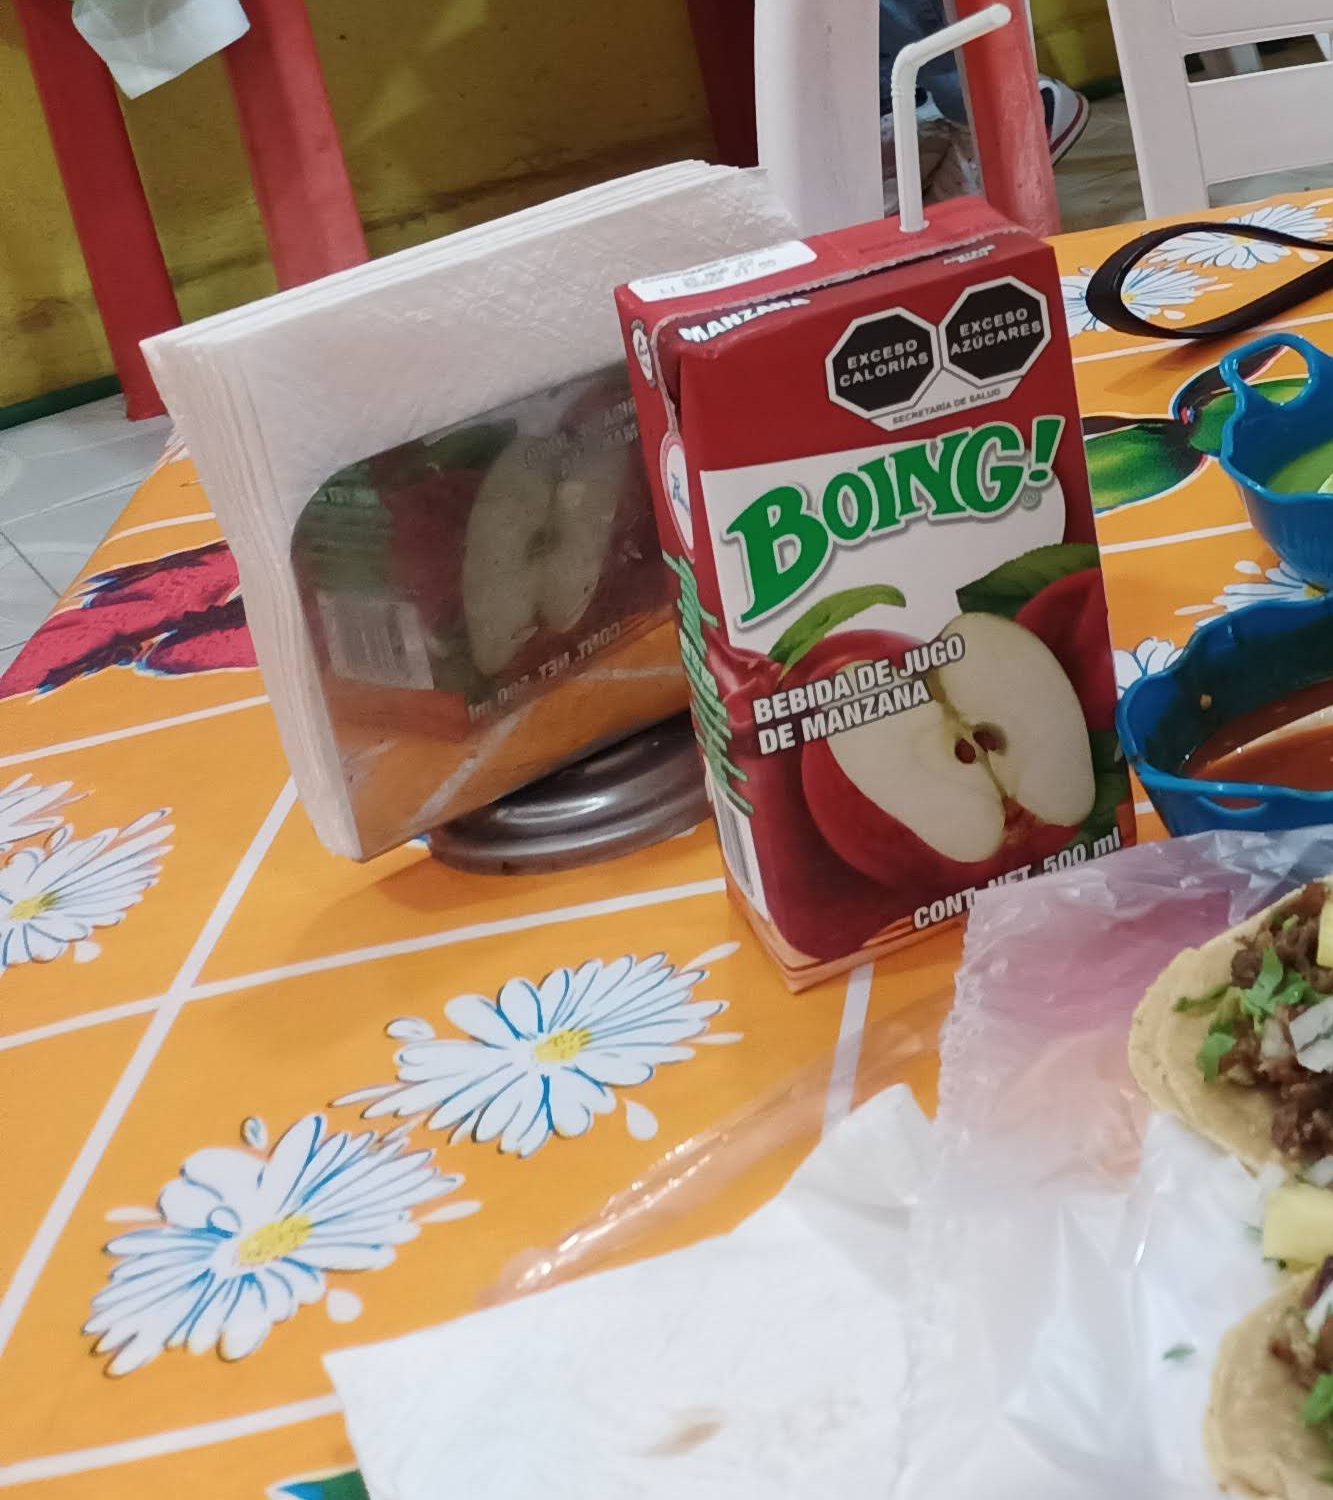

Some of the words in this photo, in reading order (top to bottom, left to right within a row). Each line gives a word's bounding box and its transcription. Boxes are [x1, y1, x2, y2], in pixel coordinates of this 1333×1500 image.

[677, 298, 811, 342] MANZANA
[950, 320, 1042, 357] AZÚCARES
[959, 307, 1028, 338] EXCESO
[839, 351, 929, 388] CALORÍAS
[847, 339, 918, 370] EXCESO
[892, 401, 952, 425] SECRETARÍA
[954, 395, 967, 408] DE
[969, 388, 1001, 404] SALUD
[724, 414, 1066, 624] BOING!
[752, 671, 853, 725] BEBIDA
[857, 659, 892, 691] DE
[899, 635, 964, 678] JUGO
[758, 722, 796, 755] DE
[801, 679, 931, 743] MANZANA
[1043, 845, 1088, 875] 500
[1093, 826, 1121, 859] ml
